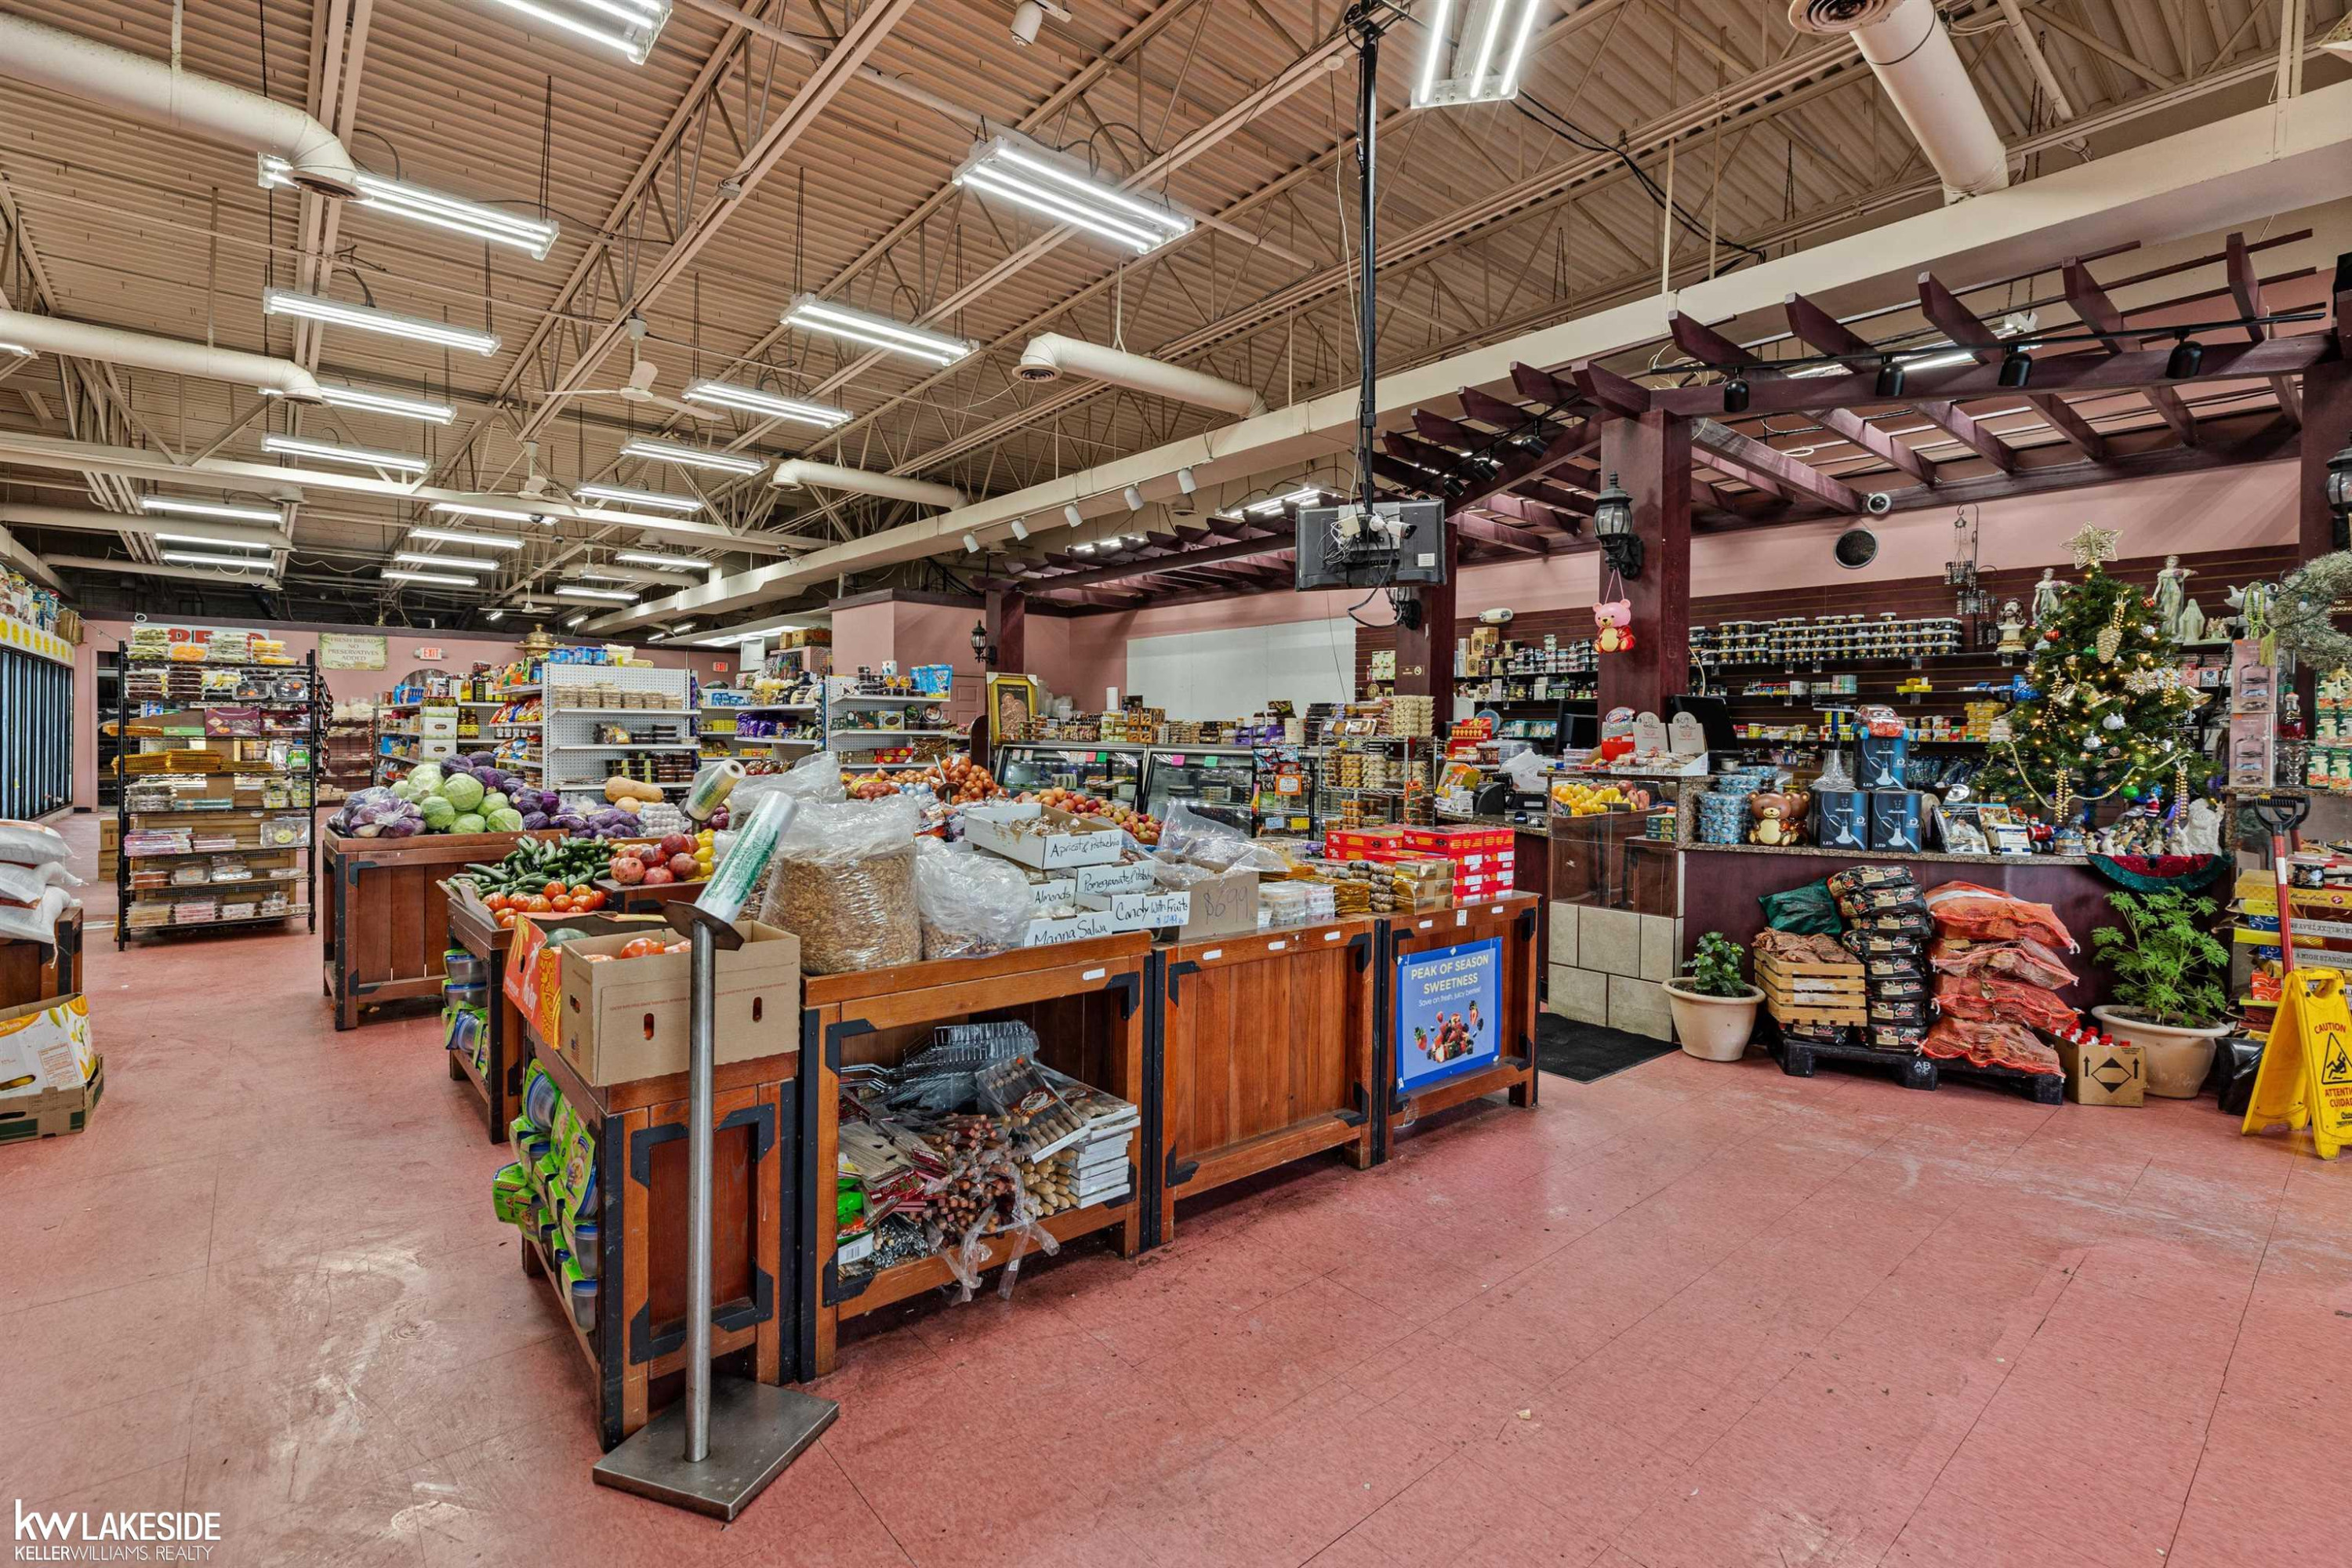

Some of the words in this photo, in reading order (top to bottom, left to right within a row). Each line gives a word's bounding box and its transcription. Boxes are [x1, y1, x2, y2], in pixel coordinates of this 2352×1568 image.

[423, 648, 438, 658] EXIT
[1051, 838, 1083, 858] Apricot
[1083, 869, 1130, 893] Pomegranate
[1035, 887, 1071, 904] Almonds
[1116, 898, 1149, 922] Candy
[1167, 897, 1189, 913] Fruits
[1035, 930, 1076, 946] Manna
[1077, 919, 1108, 938] Salwa
[1411, 965, 1438, 981] PEAK
[1439, 962, 1453, 975] OF
[1454, 954, 1489, 971] SEASON
[1423, 972, 1478, 994] SWEETNESS
[1418, 998, 1432, 1007] Save
[1440, 993, 1454, 1002] fresh,
[1454, 990, 1465, 1000] juicy
[2314, 1022, 2346, 1034] CAUTION
